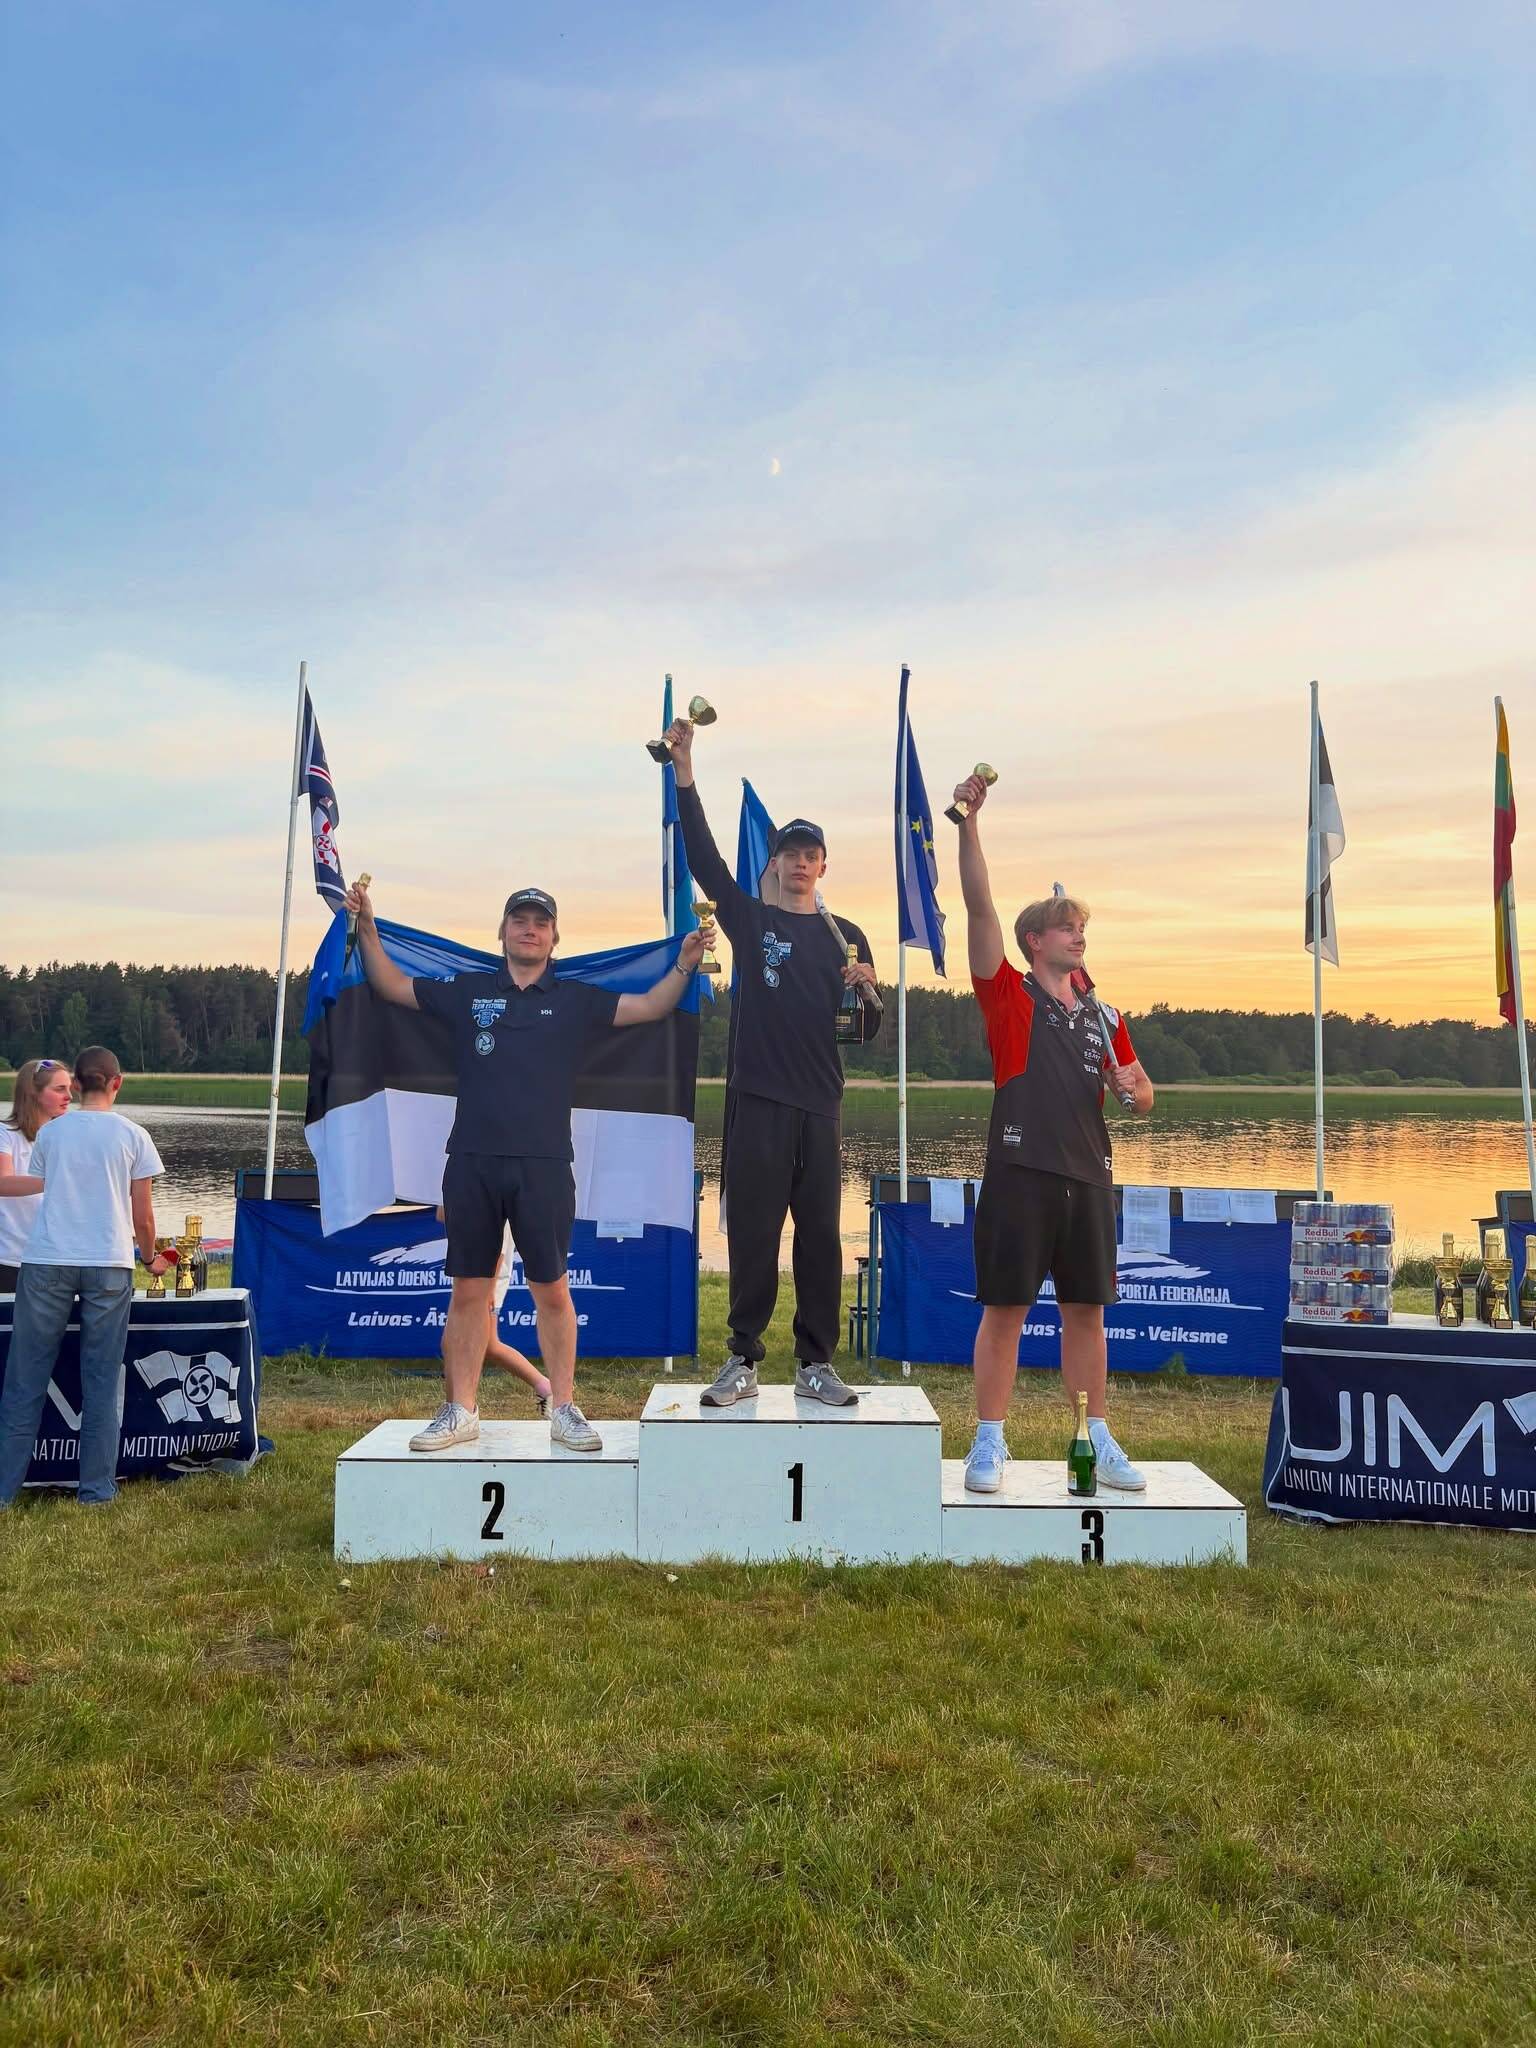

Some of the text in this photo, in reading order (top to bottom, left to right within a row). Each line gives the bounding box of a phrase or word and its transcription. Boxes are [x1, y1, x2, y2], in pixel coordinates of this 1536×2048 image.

[1305, 1228, 1338, 1237] Red Bull
[336, 1271, 395, 1287] LATVIJAS
[397, 1269, 436, 1286] ŪDENS
[1303, 1267, 1336, 1276] Red Bull
[1160, 1285, 1231, 1304] FEDERĀCIJA
[347, 1311, 413, 1327] Laivas
[1302, 1306, 1336, 1316] Red Bull
[1148, 1326, 1229, 1344] Veiksme
[1282, 1386, 1497, 1477] UIM
[786, 1462, 803, 1522] 1
[1283, 1466, 1333, 1496] UNION
[1339, 1473, 1494, 1511] INTERNATIONALE
[480, 1481, 506, 1540] 2
[1080, 1509, 1105, 1566] 3
